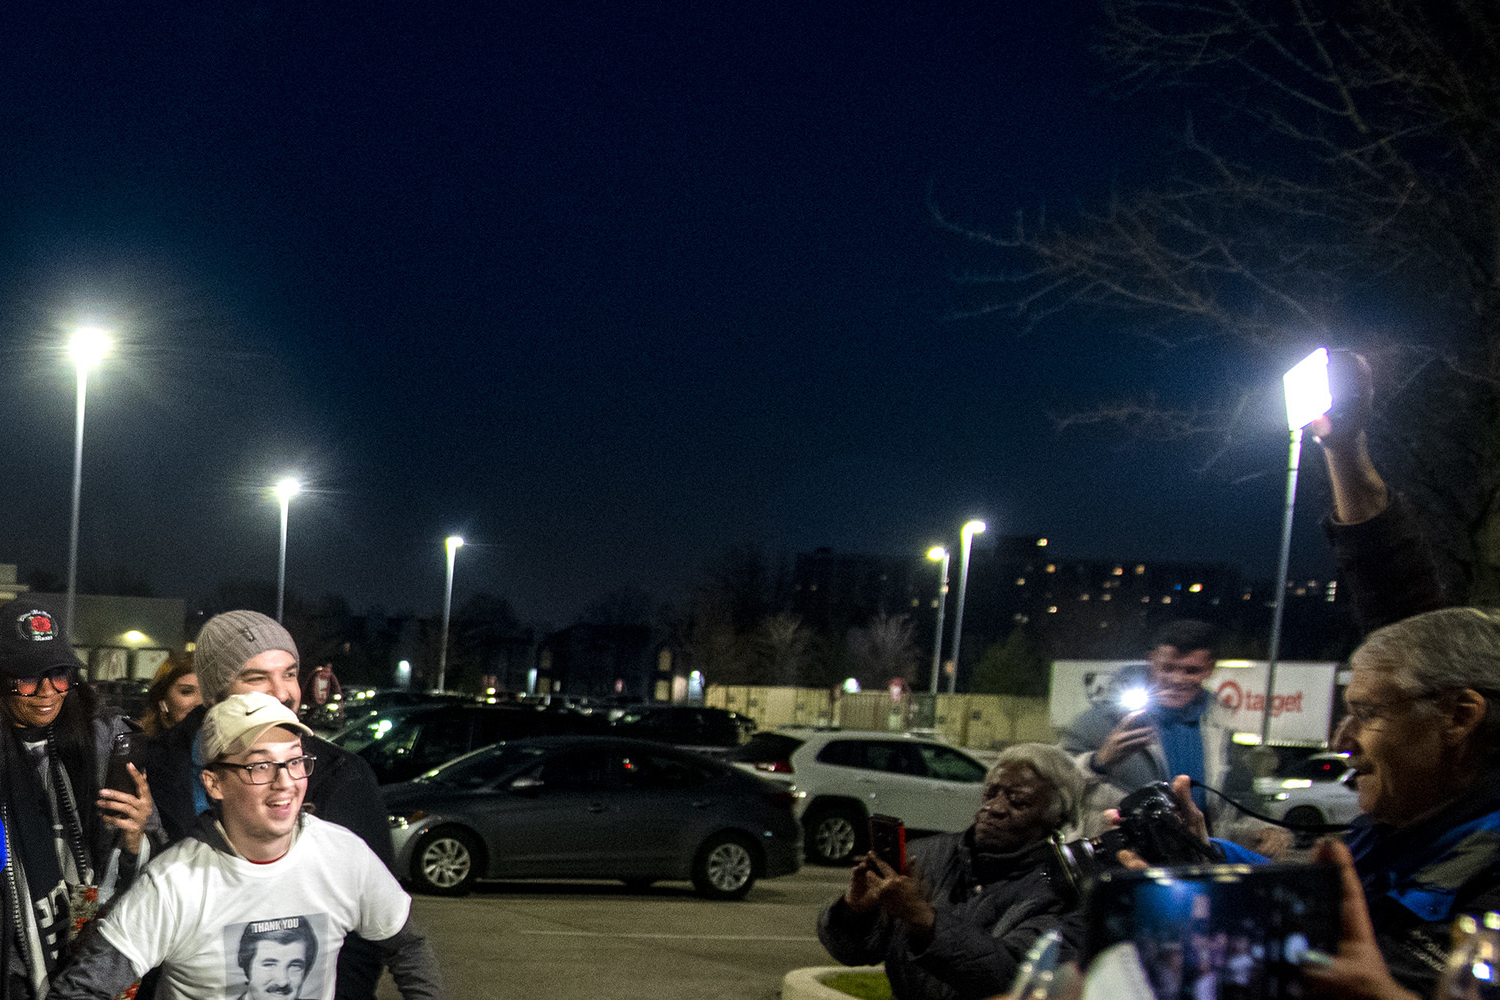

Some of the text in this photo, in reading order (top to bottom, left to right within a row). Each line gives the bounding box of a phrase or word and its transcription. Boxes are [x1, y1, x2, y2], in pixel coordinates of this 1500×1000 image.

[1245, 691, 1303, 718] taget
[253, 918, 299, 933] THANK YOU
